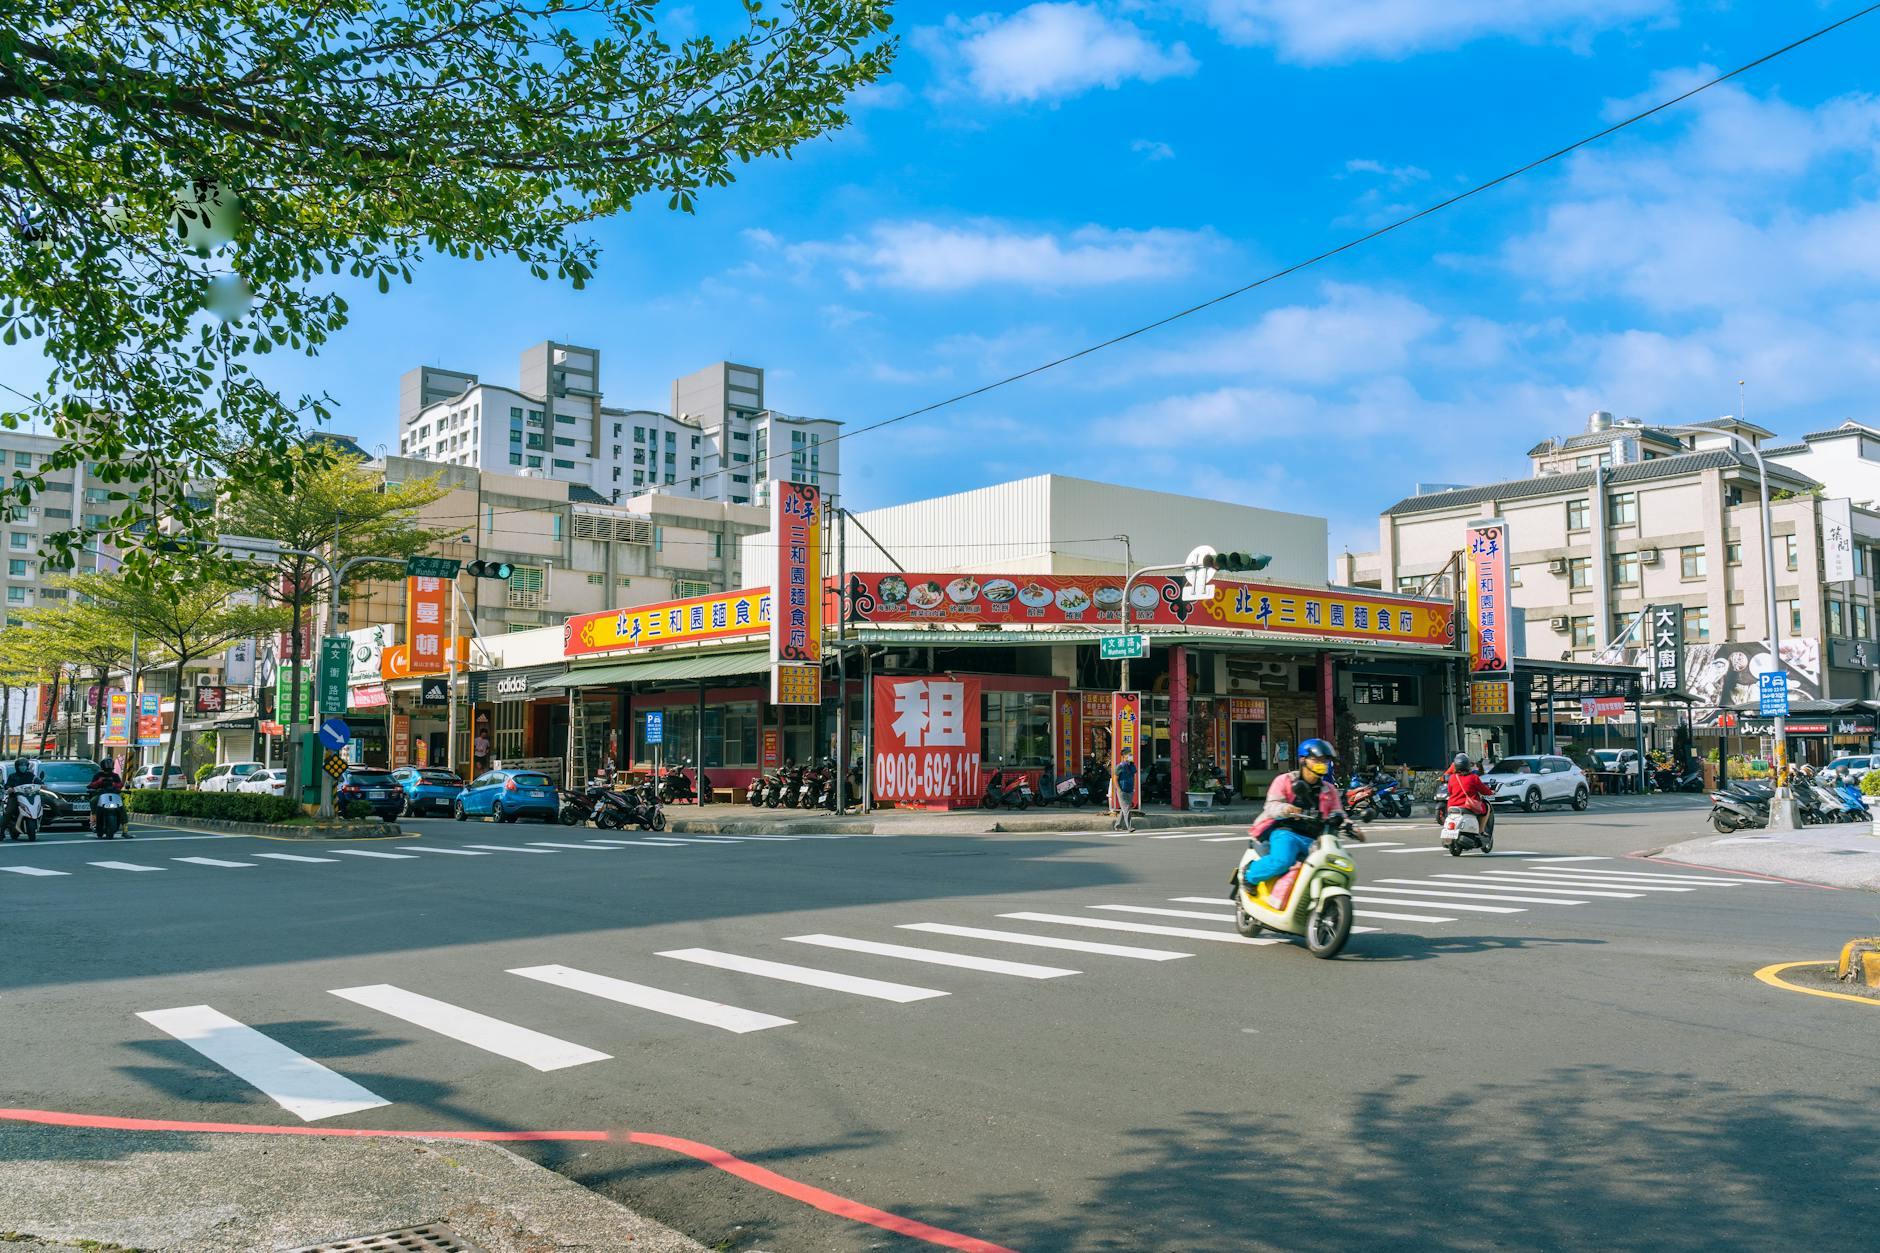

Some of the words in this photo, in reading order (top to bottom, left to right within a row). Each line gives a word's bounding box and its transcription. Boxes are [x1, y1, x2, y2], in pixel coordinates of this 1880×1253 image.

[439, 569, 449, 577] Rd
[785, 494, 816, 647] 北平三和園麵食府
[616, 596, 770, 646] 北平三和園麵食府
[1235, 585, 1412, 630] 北平三和園麵食府
[1472, 538, 1499, 660] 北平三和園麵食府
[1656, 608, 1677, 689] 大大廚房
[199, 687, 221, 710] 港式
[498, 676, 527, 693] adidas
[1761, 675, 1770, 687] P
[647, 715, 653, 724] P
[891, 680, 966, 747] 租
[876, 752, 979, 798] 0908-692-117
